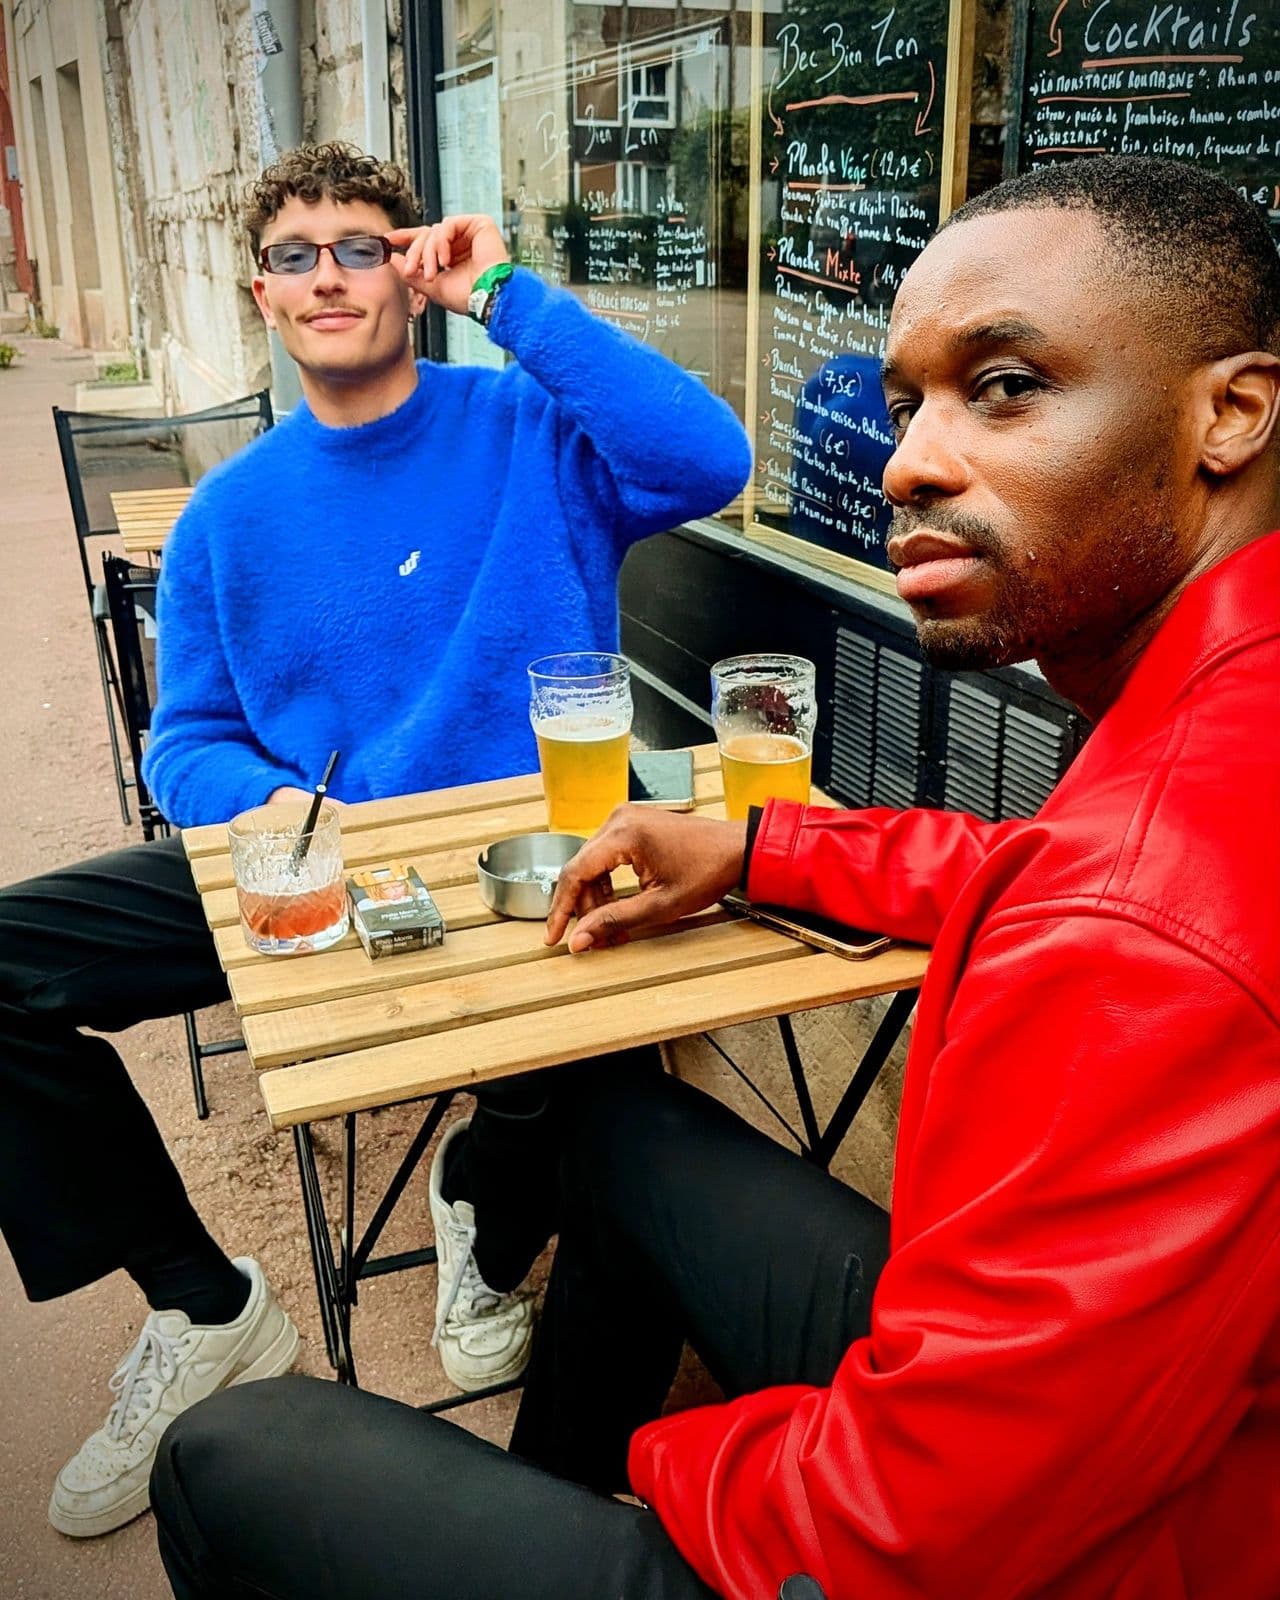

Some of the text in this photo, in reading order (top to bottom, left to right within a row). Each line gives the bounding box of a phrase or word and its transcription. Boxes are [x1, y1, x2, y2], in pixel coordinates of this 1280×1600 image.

[776, 7, 918, 90] Bec Bien Zen
[1217, 66, 1258, 88] Rhum
[1074, 106, 1103, 129] purée
[1105, 105, 1118, 124] de
[786, 141, 836, 176] Planche
[841, 147, 870, 185] Végé
[1203, 136, 1252, 163] liqueur
[1256, 134, 1270, 154] de
[895, 226, 926, 249] Savoie
[777, 236, 820, 272] Planche
[826, 248, 862, 285] Mixte
